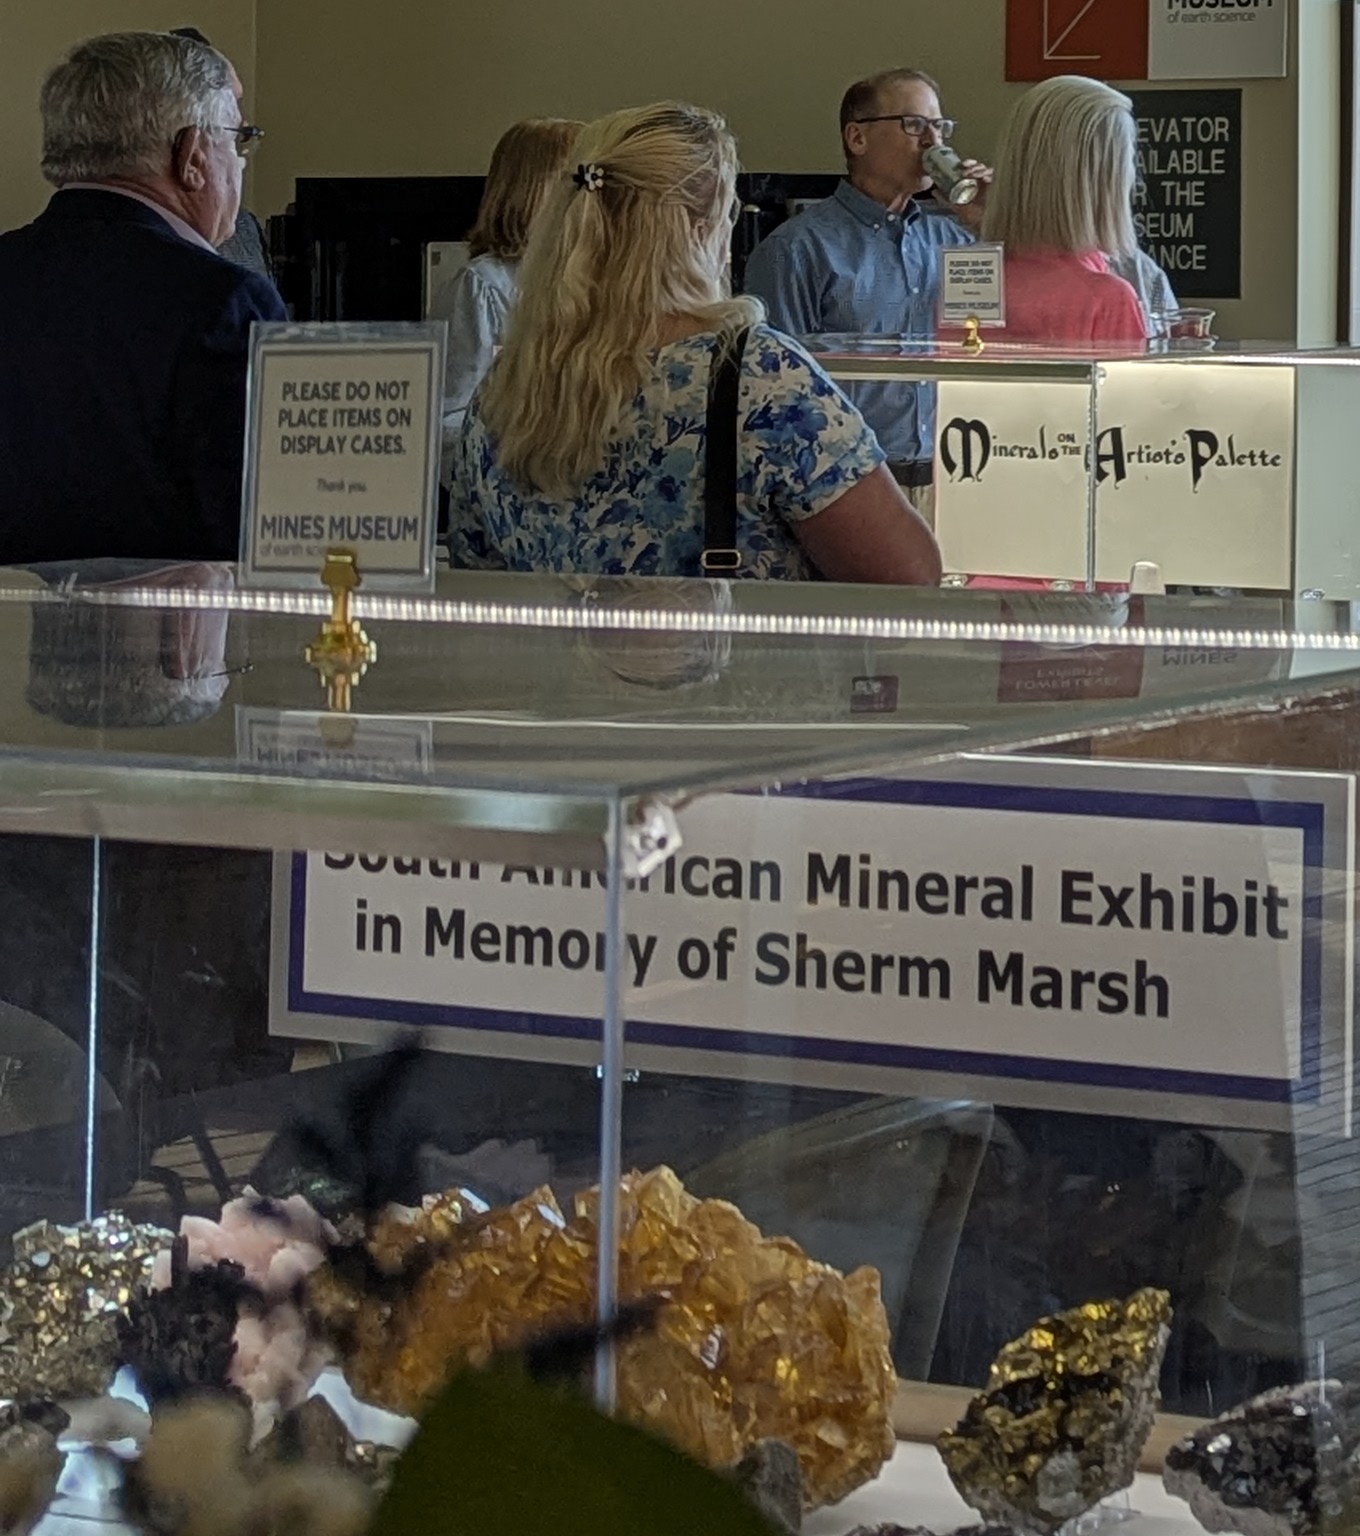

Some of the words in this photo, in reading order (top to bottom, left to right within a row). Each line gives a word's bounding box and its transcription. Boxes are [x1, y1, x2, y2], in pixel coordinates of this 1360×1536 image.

[1166, 11, 1179, 24] of
[1181, 11, 1211, 23] earth
[1212, 10, 1256, 23] science
[1138, 117, 1229, 143] EVATOR
[1136, 148, 1226, 175] AILABLE
[1161, 181, 1205, 207] THE
[1133, 213, 1194, 238] SEUM
[1147, 244, 1207, 270] ANCE
[282, 380, 341, 402] PLEASE
[345, 380, 371, 401] DO
[375, 380, 410, 401] NOT
[278, 407, 328, 428] PLACE
[332, 407, 382, 428] ITEMS
[386, 407, 412, 428] ON
[280, 434, 347, 455] DISPLAY
[350, 434, 407, 455] CASES.
[940, 418, 1059, 483] Minerals
[1057, 432, 1076, 444] ON
[1062, 444, 1082, 456] THE
[1084, 427, 1186, 490] Artist's
[1184, 429, 1282, 494] Palette
[317, 478, 345, 493] Thank
[260, 514, 324, 540] MINES
[329, 514, 419, 541] MUSEUM
[501, 852, 782, 904] ican
[807, 852, 1034, 921] Mineral
[1060, 869, 1290, 941] Exhibit
[355, 898, 402, 955] in
[425, 906, 658, 988] Memory
[677, 927, 737, 980] of
[754, 932, 951, 1000] Sherm
[978, 949, 1169, 1018] Marsh
